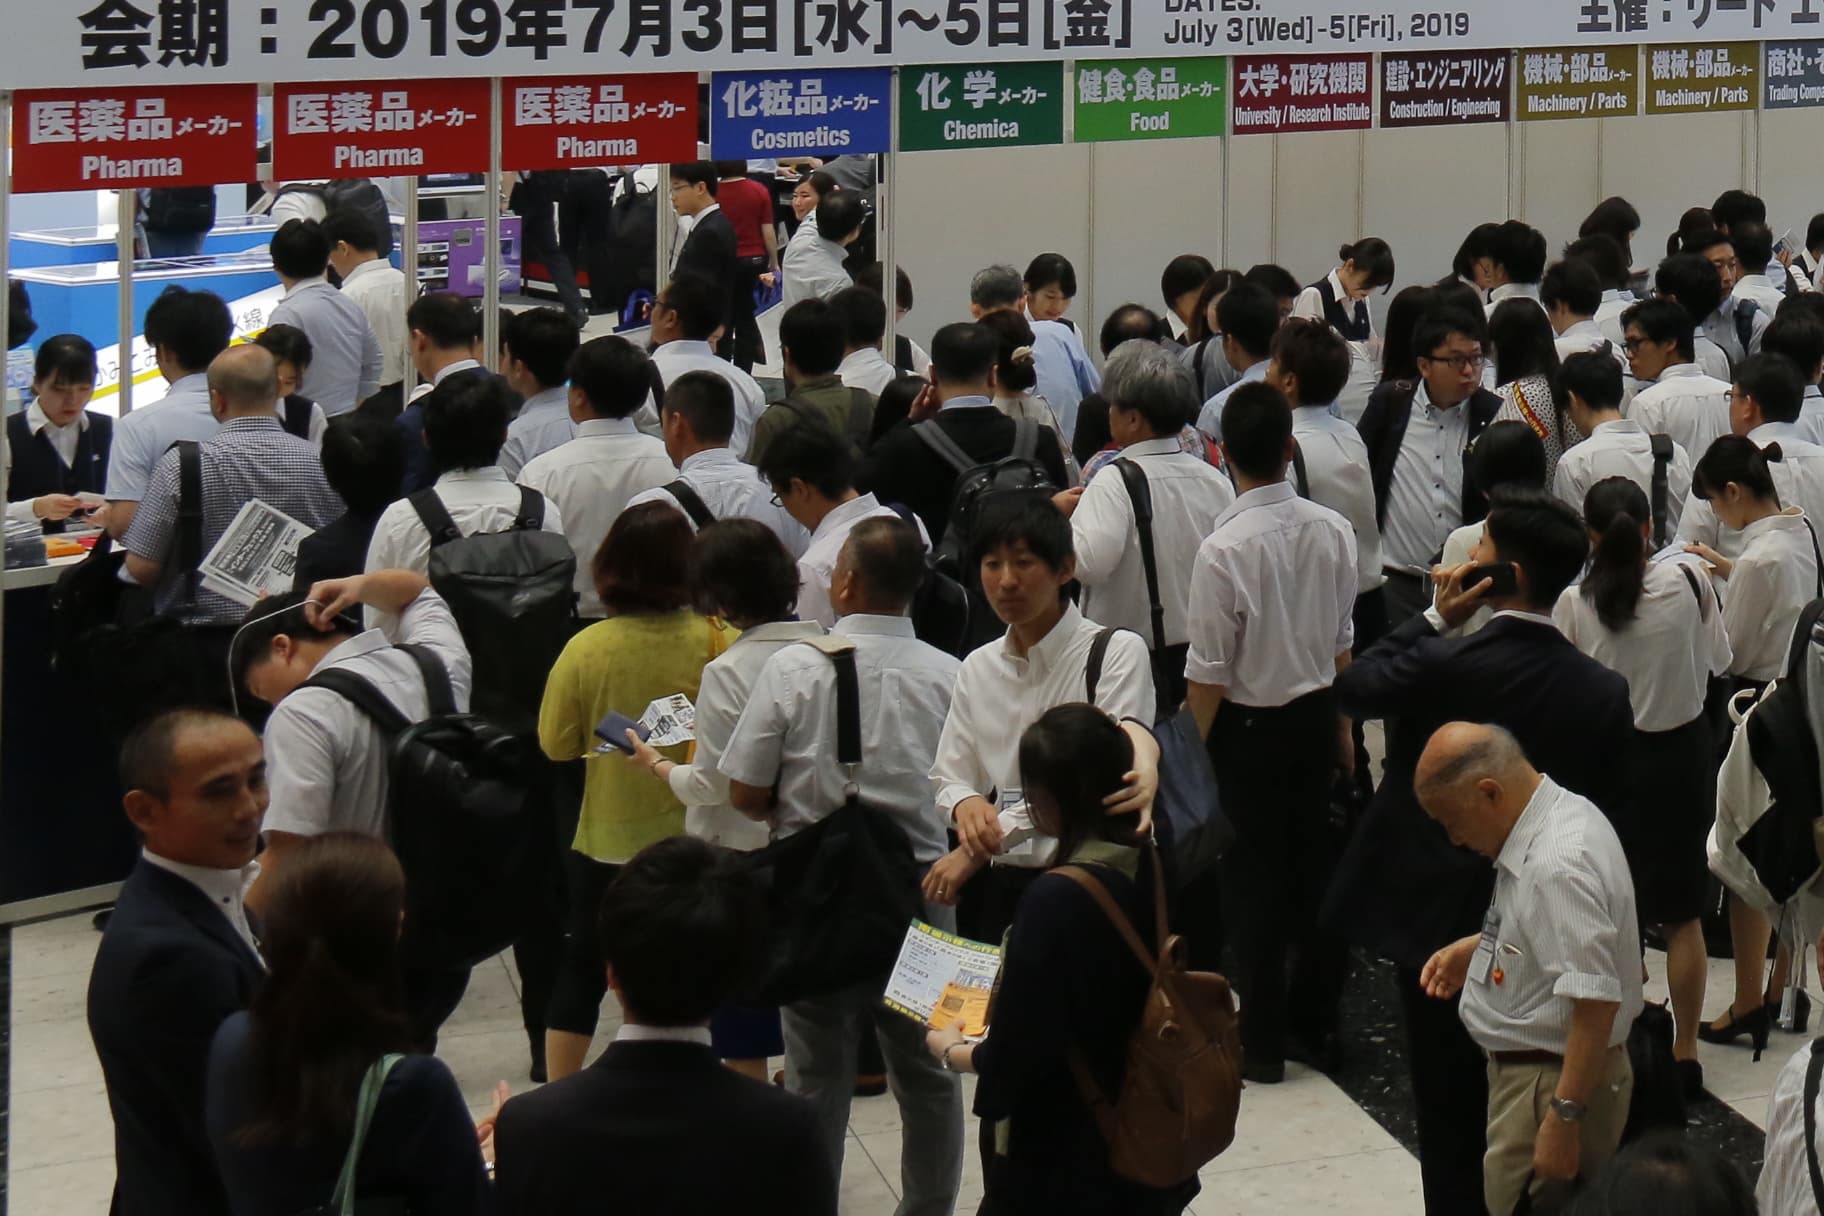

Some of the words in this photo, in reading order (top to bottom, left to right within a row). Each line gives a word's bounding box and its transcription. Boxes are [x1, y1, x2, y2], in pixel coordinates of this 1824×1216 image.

[1164, 18, 1218, 47] July
[1410, 12, 1469, 38] 2019
[1527, 92, 1588, 114] Machinery
[1597, 92, 1627, 111] Parts
[1768, 84, 1798, 103] Trading
[1234, 106, 1280, 128] University
[1289, 103, 1331, 122] Research
[1332, 102, 1370, 121] Institute
[1389, 100, 1444, 120] Construction
[1451, 97, 1501, 118] Engineering
[943, 118, 1020, 141] Chemica
[1130, 111, 1170, 132] Food
[556, 134, 638, 159] Pharma
[751, 126, 850, 151] Cosmetics
[82, 154, 183, 181] Pharma
